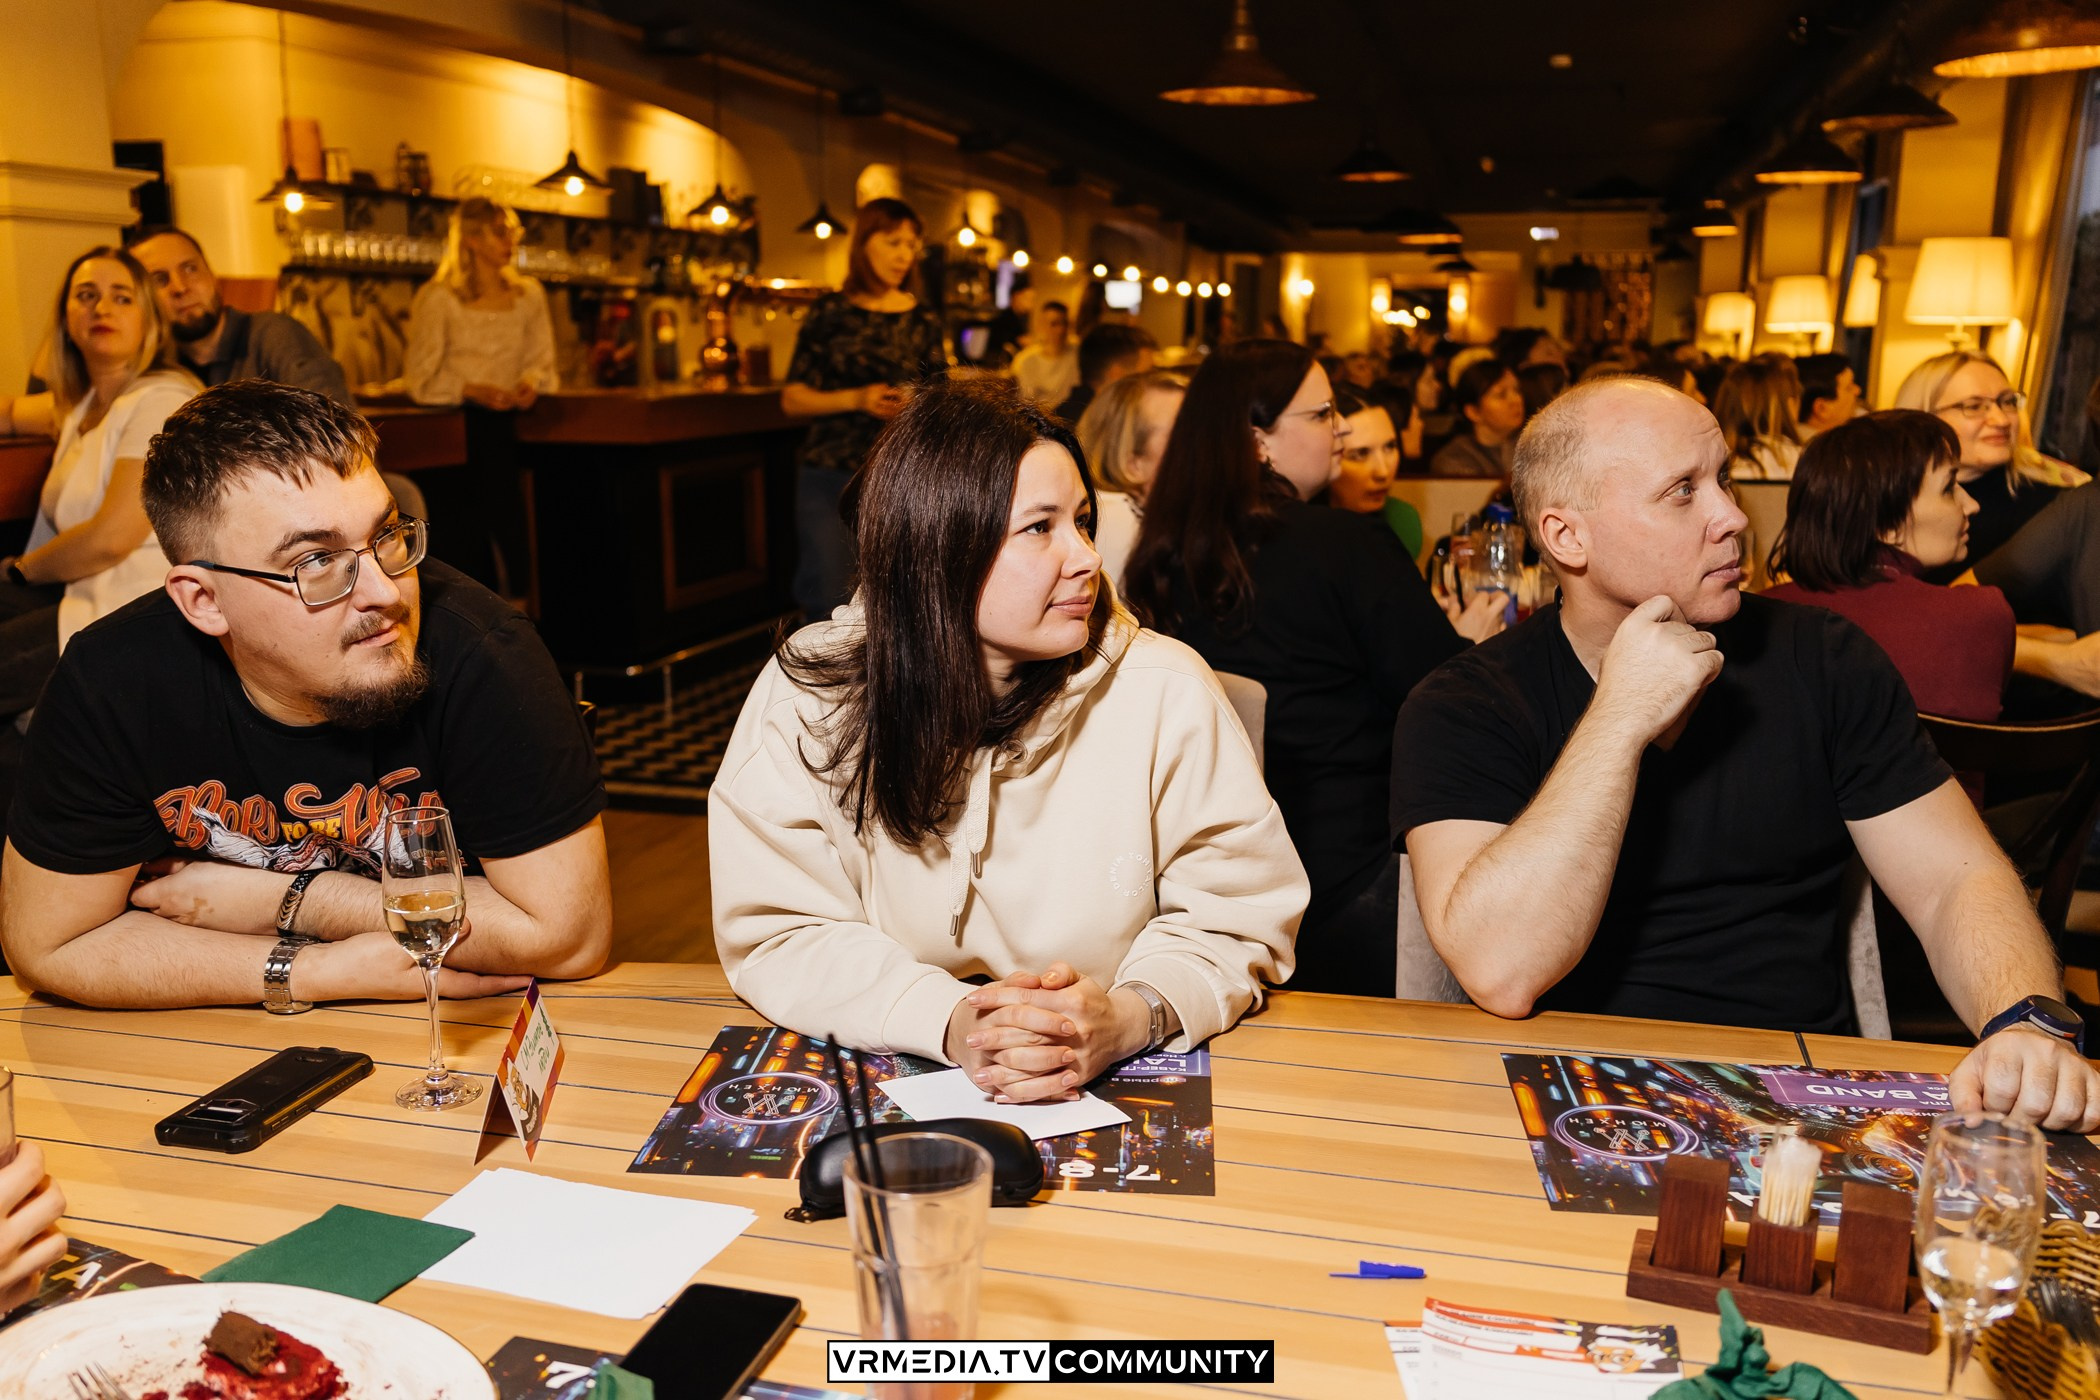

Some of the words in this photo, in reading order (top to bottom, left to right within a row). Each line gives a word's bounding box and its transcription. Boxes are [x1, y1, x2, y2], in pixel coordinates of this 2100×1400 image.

[728, 1083, 820, 1094] МЮНХЕН
[1805, 1084, 1918, 1100] BAND
[1568, 1117, 1667, 1128] МЮНХЕН
[1058, 1160, 1161, 1182] 7-8
